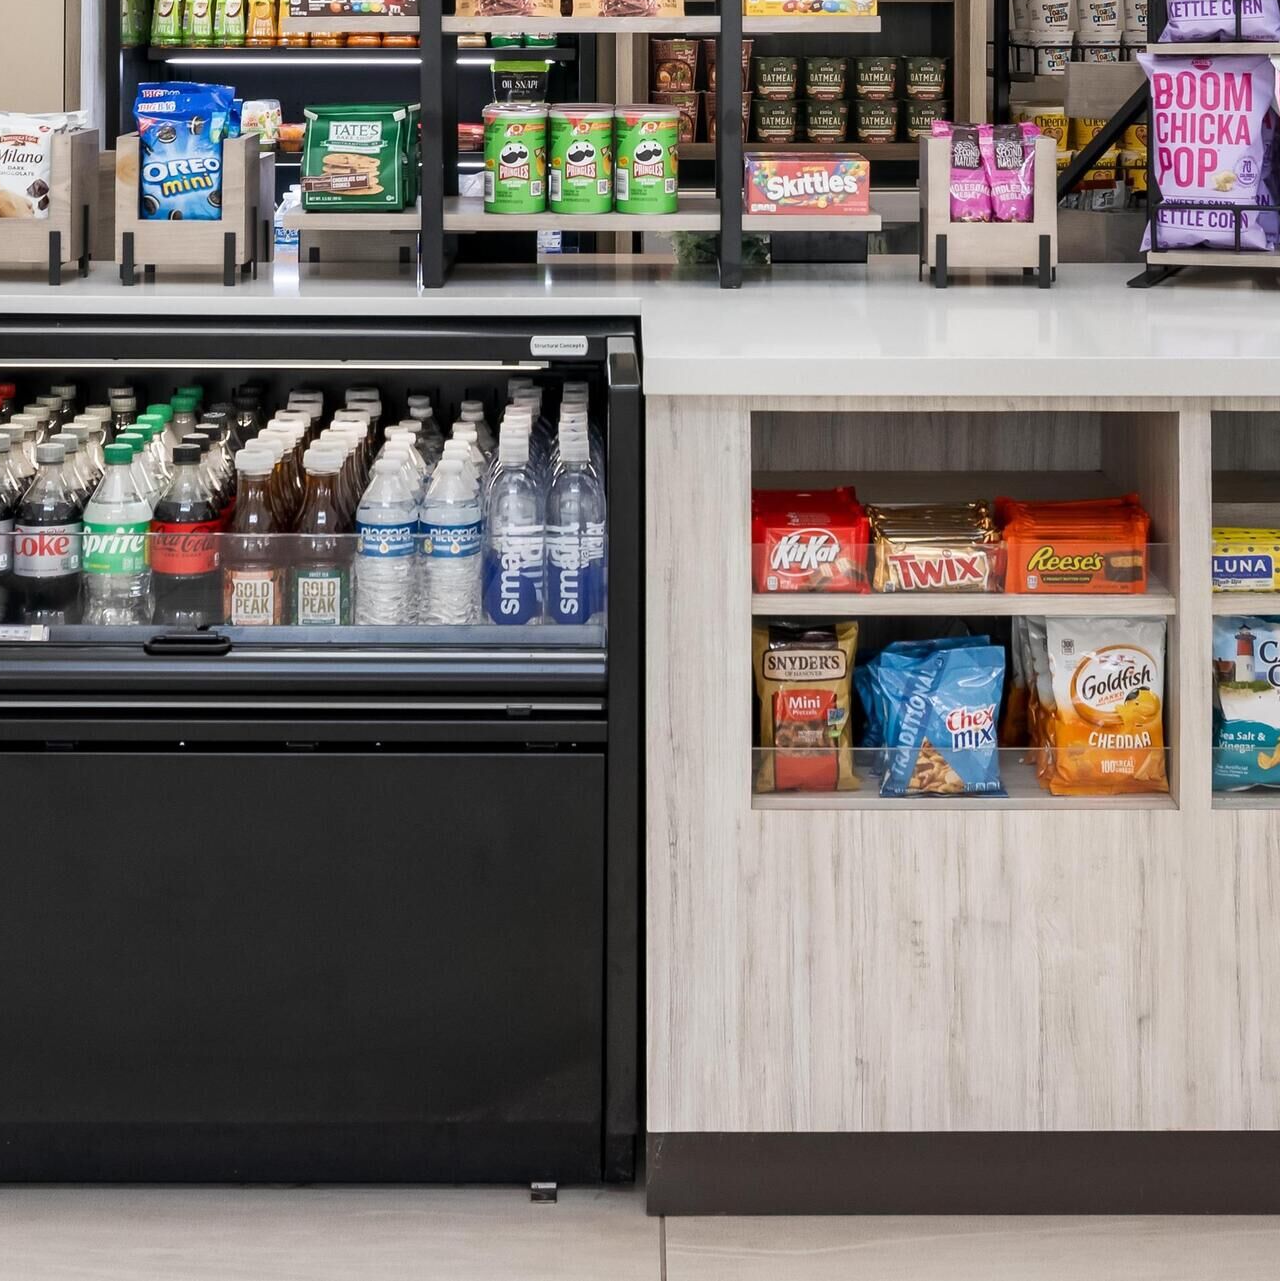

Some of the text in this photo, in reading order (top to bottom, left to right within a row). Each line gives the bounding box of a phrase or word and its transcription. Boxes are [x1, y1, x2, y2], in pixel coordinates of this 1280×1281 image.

[762, 73, 794, 82] OATMEAL
[810, 73, 841, 82] OATMEAL
[860, 72, 892, 82] OATMEAL
[910, 73, 942, 82] OATMEAL
[1152, 72, 1253, 112] BOOM
[762, 116, 793, 125] OATMEAL
[809, 116, 840, 125] OATMEAL
[861, 116, 892, 125] OATMEAL
[333, 125, 379, 136] TATE'S
[1156, 112, 1251, 145] CHICKA
[955, 157, 979, 168] NATURE
[1158, 147, 1218, 188] POP
[1242, 160, 1252, 174] 70
[143, 158, 220, 183] OREO
[500, 164, 529, 179] PRINGLES
[566, 164, 596, 178] PRINGLES
[634, 164, 663, 178] PRINGLES
[162, 173, 213, 197] mini
[766, 171, 859, 201] Skittles
[83, 526, 145, 557] Sprite
[772, 535, 841, 570] KitKat
[1027, 545, 1104, 571] Reese's
[1214, 559, 1266, 573] LUNA
[236, 582, 269, 598] GOLD
[302, 581, 336, 597] GOLD
[236, 598, 269, 614] PEAK
[302, 598, 336, 613] PEAK
[768, 656, 840, 670] SNYDER'S
[1082, 664, 1151, 700] Goldfish
[789, 696, 821, 709] Mini
[891, 669, 937, 776] TRADITIONAL
[946, 704, 996, 732] Chex
[1089, 731, 1151, 749] CHEDDAR
[1236, 731, 1266, 741] Salt &
